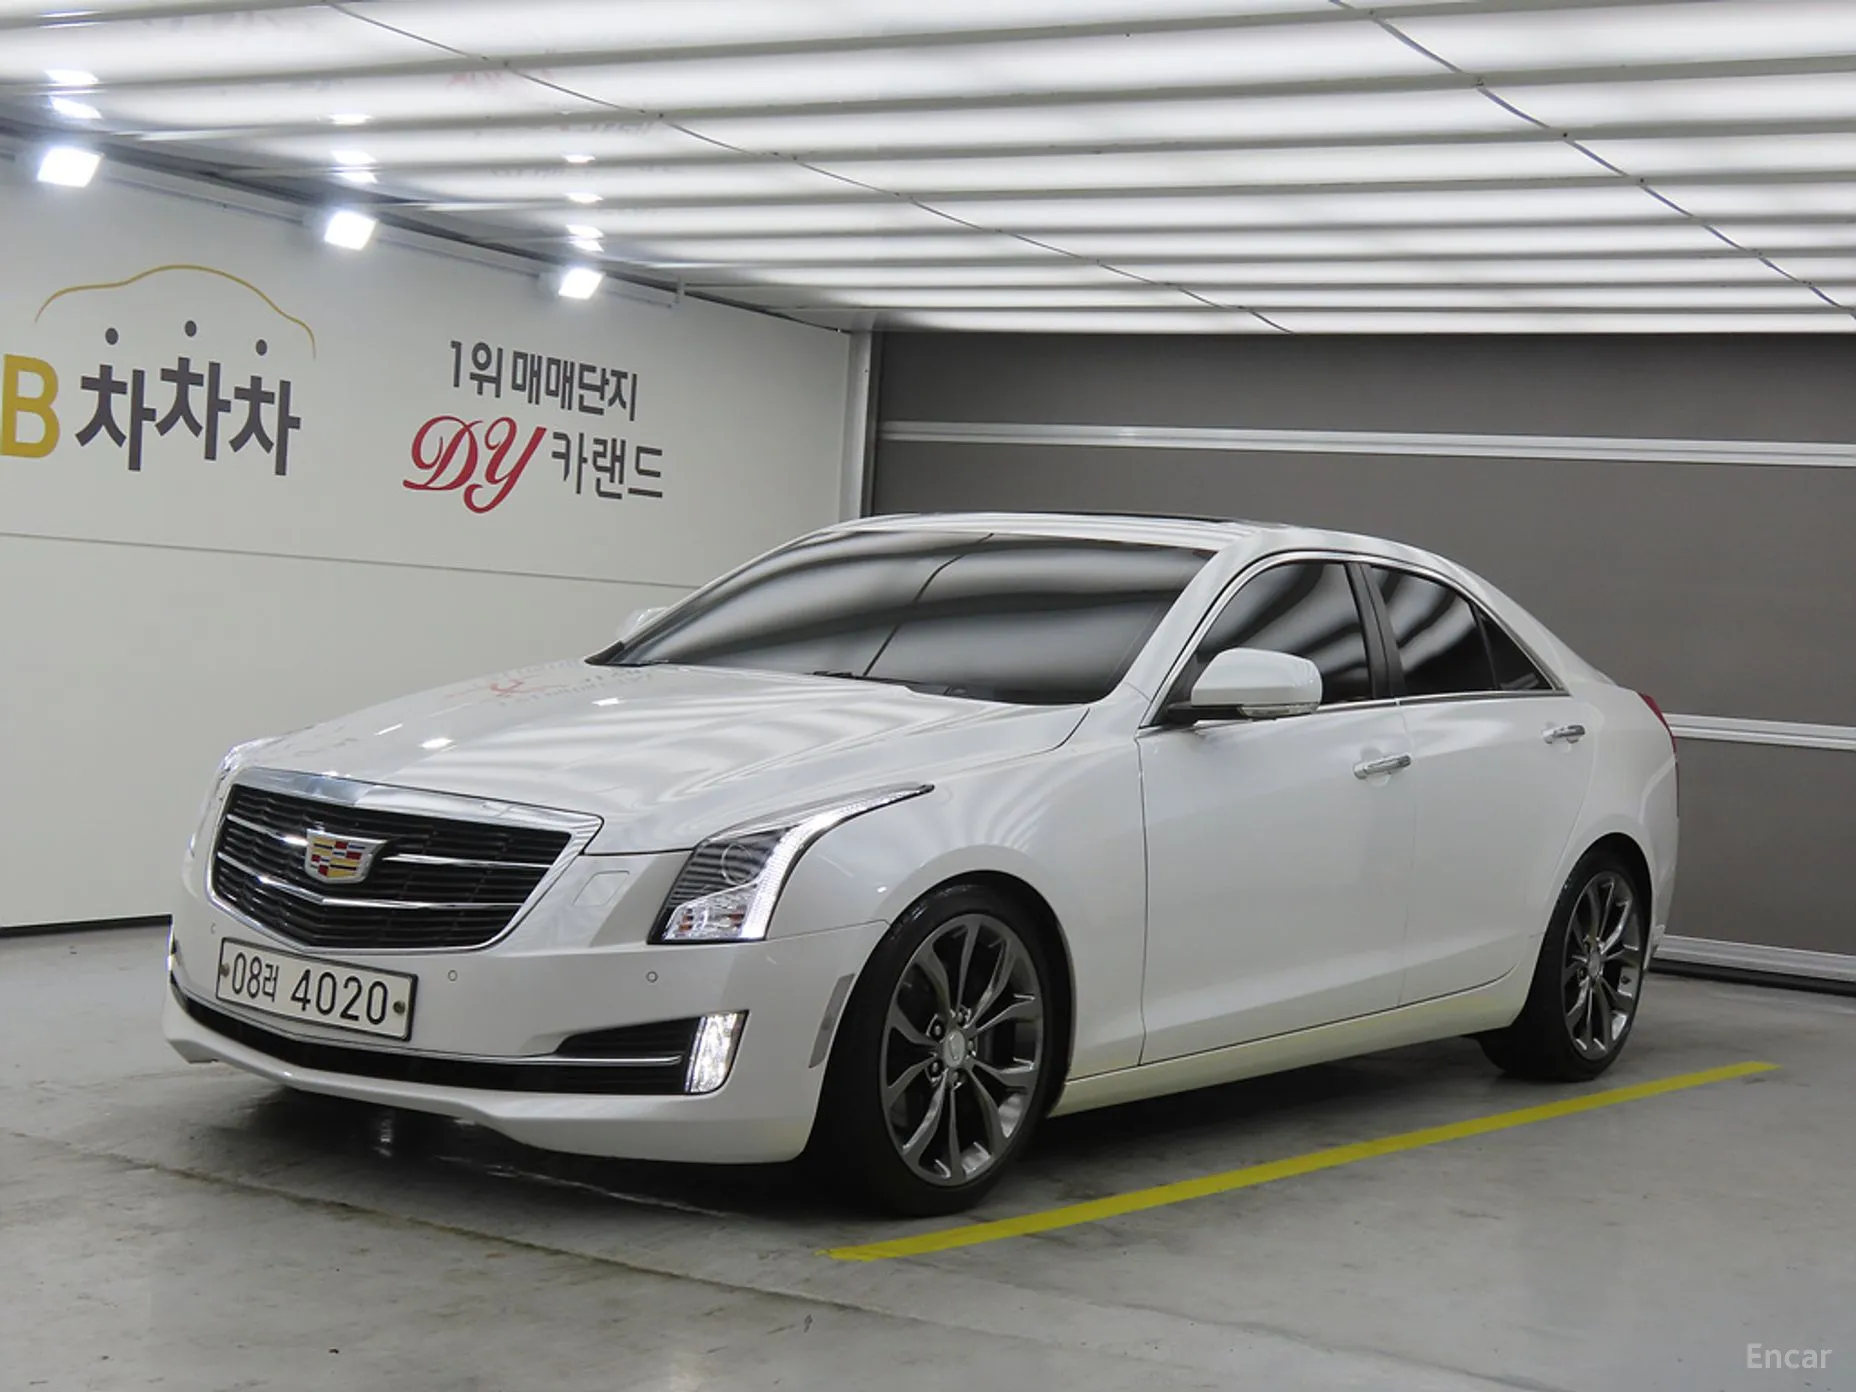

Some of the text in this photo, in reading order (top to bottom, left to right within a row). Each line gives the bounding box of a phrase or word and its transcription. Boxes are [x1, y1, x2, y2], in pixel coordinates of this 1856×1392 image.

[450, 340, 638, 422] 1위 매매단지
[402, 415, 664, 513] DY 카랜드
[232, 952, 388, 1025] 08러 4020
